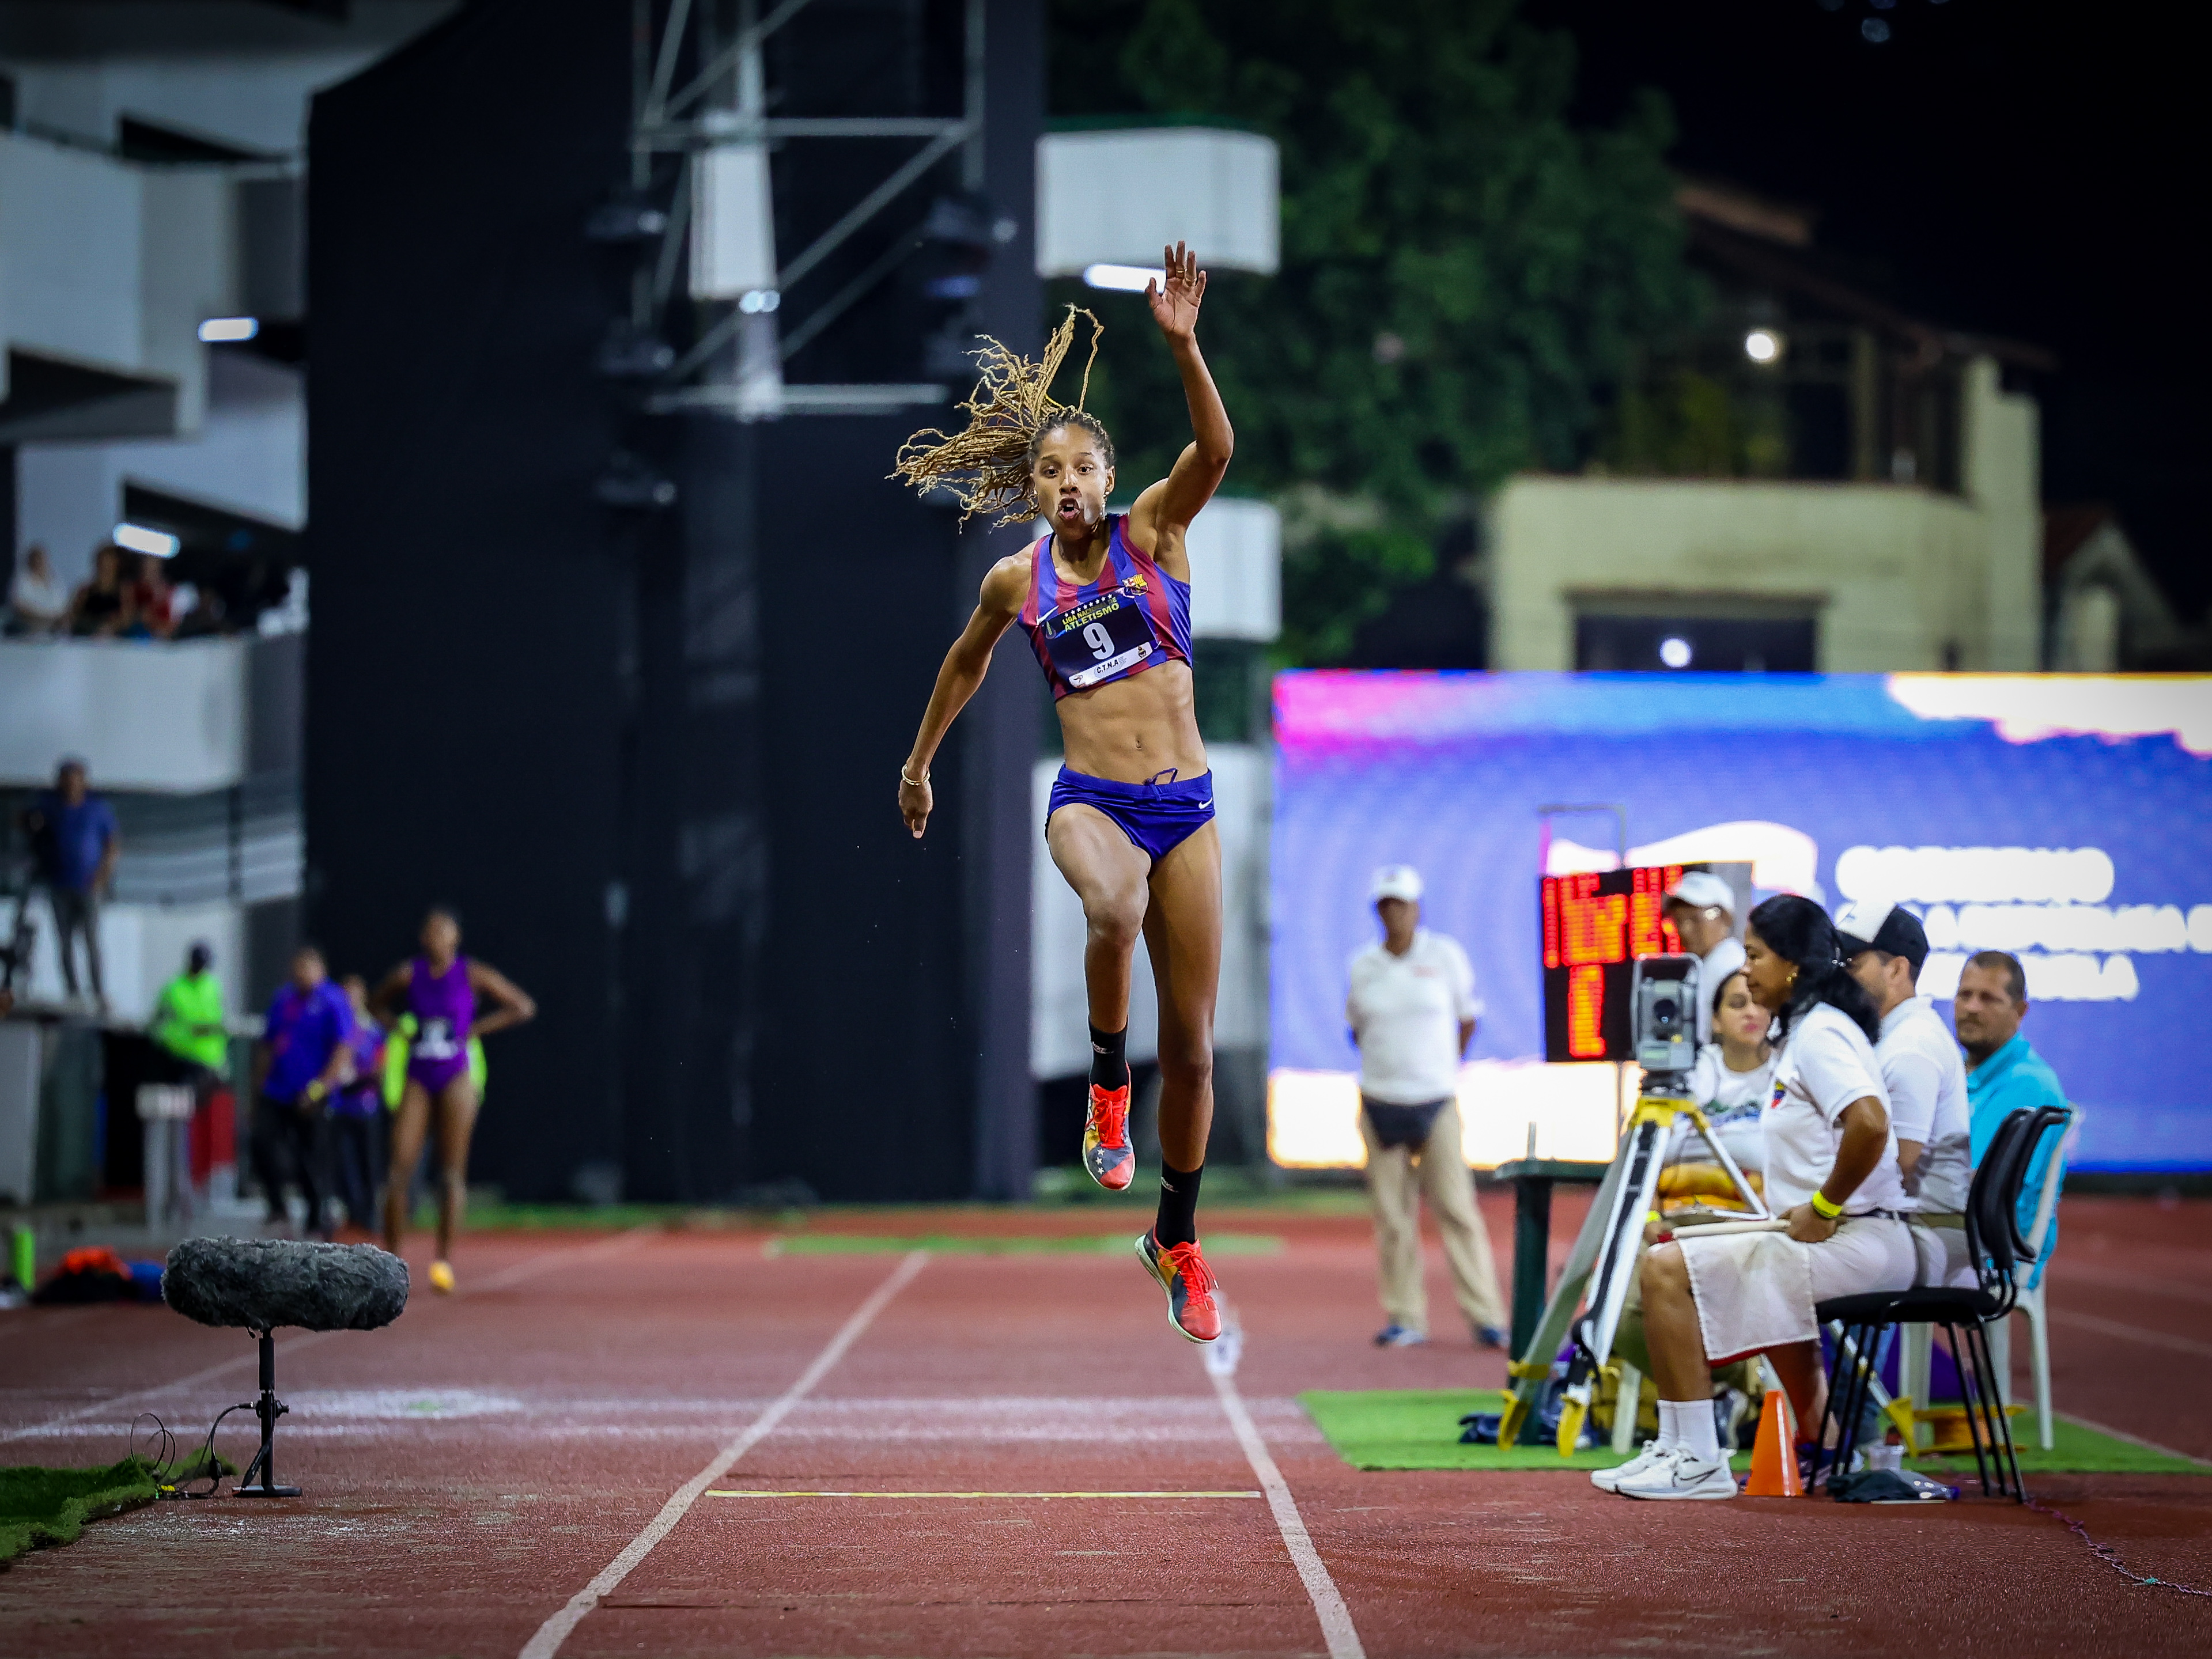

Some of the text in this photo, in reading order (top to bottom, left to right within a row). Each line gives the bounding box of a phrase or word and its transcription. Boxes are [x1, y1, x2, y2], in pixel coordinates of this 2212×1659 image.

[1062, 615, 1077, 625] LIGA
[1065, 603, 1120, 632] ATLETISMO
[1083, 622, 1115, 660] 9
